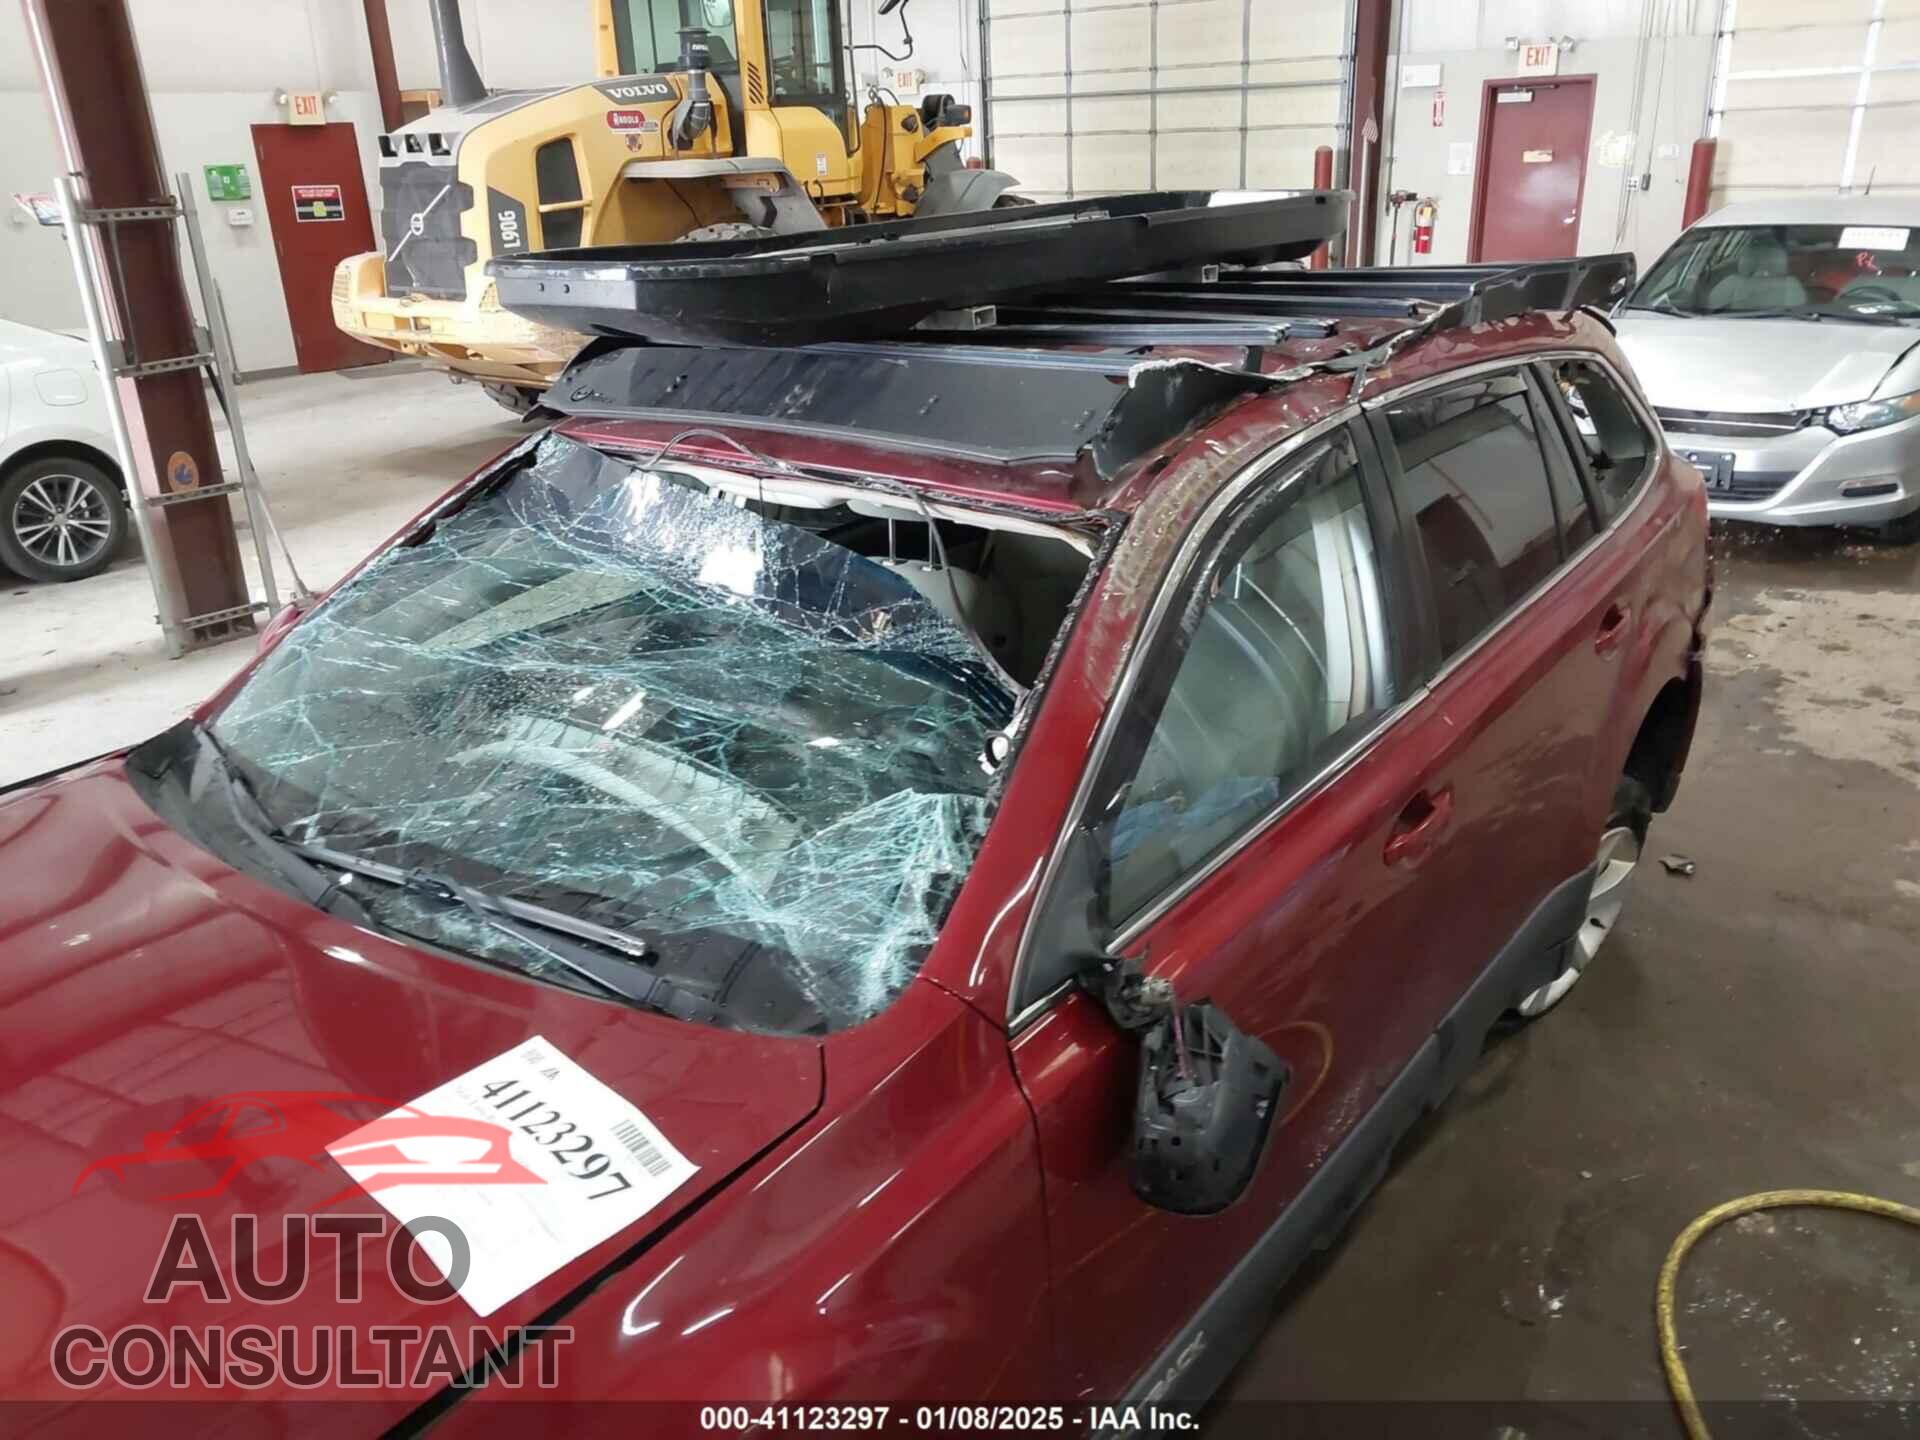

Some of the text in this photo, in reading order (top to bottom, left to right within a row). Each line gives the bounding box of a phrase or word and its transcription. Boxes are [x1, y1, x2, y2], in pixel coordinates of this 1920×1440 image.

[1526, 46, 1552, 67] EXIT
[606, 83, 668, 99] VOLVO
[294, 95, 318, 116] EXIT
[497, 209, 521, 249] L90G
[477, 1079, 632, 1200] 41123297
